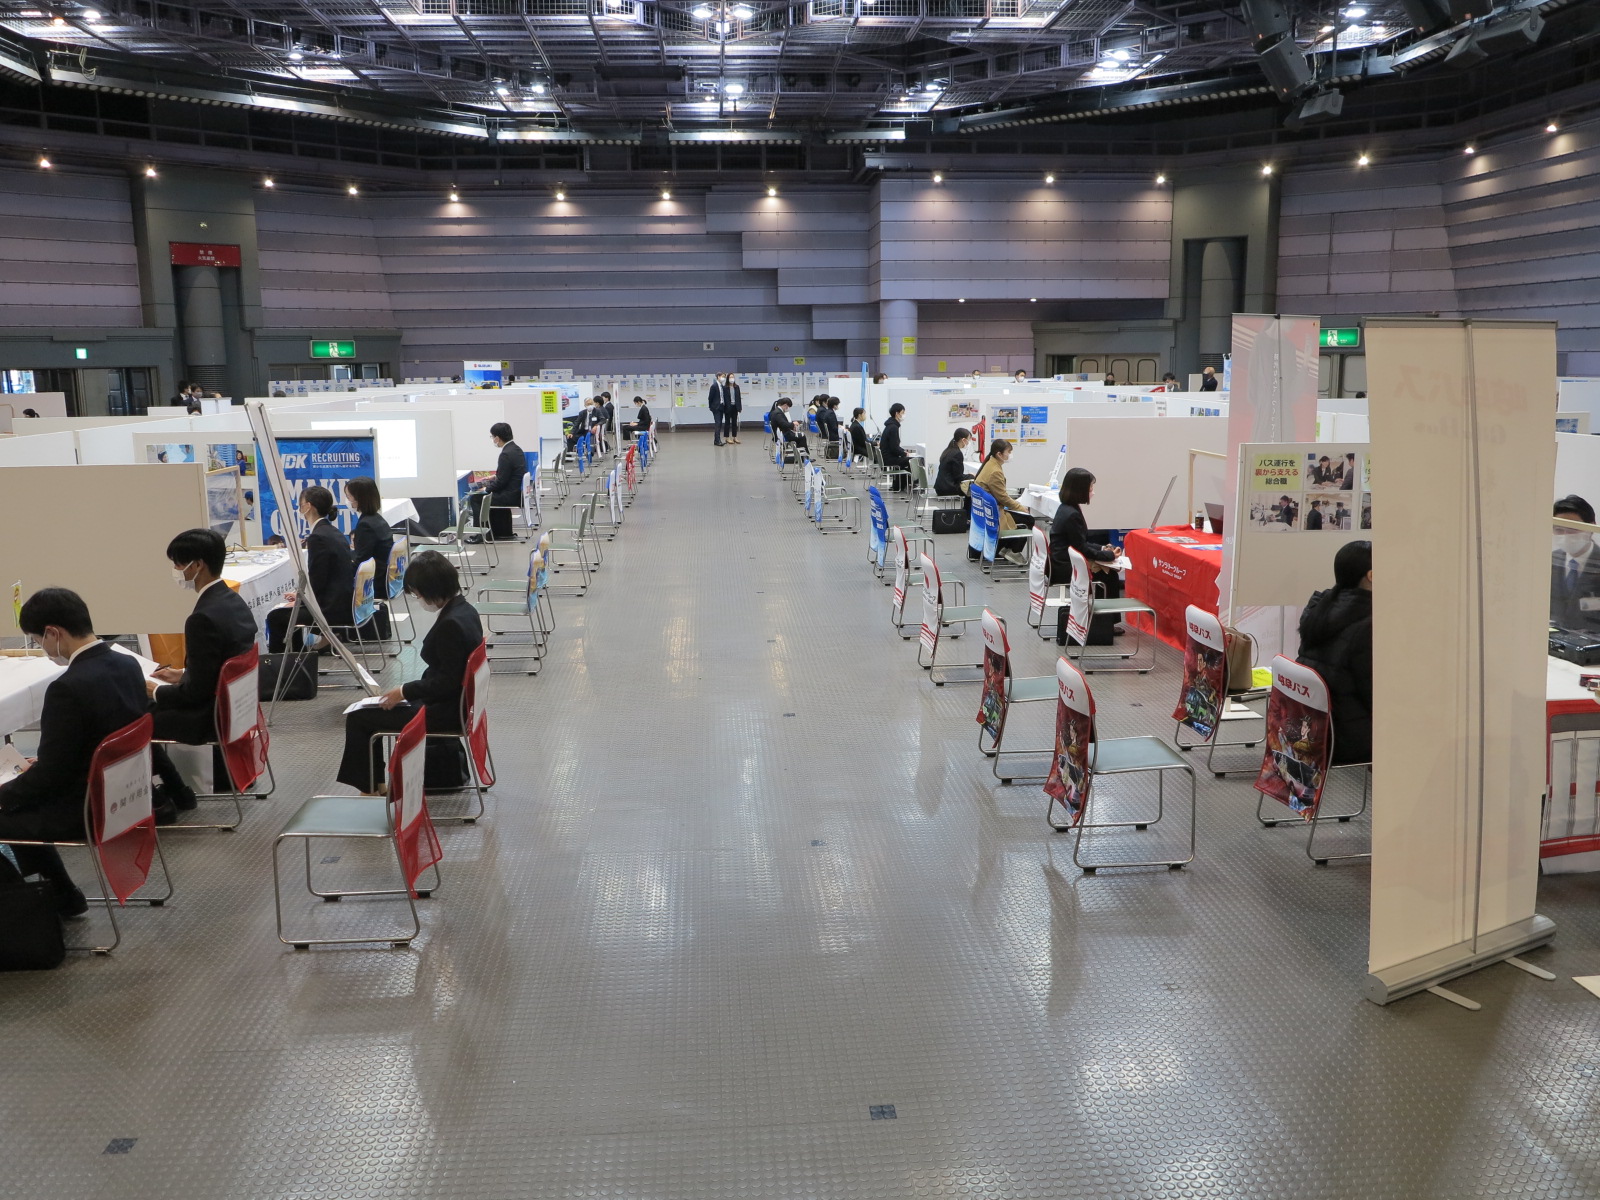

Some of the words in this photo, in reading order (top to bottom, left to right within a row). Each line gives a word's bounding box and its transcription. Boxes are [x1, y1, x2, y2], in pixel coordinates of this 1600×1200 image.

[311, 452, 360, 463] RECRUITING
[1258, 459, 1296, 467] バス運行を
[1255, 468, 1299, 476] 裏から支える
[1265, 477, 1288, 485] 総合職
[1189, 622, 1212, 641] 岐阜バス
[1278, 673, 1310, 698] 岐阜バス
